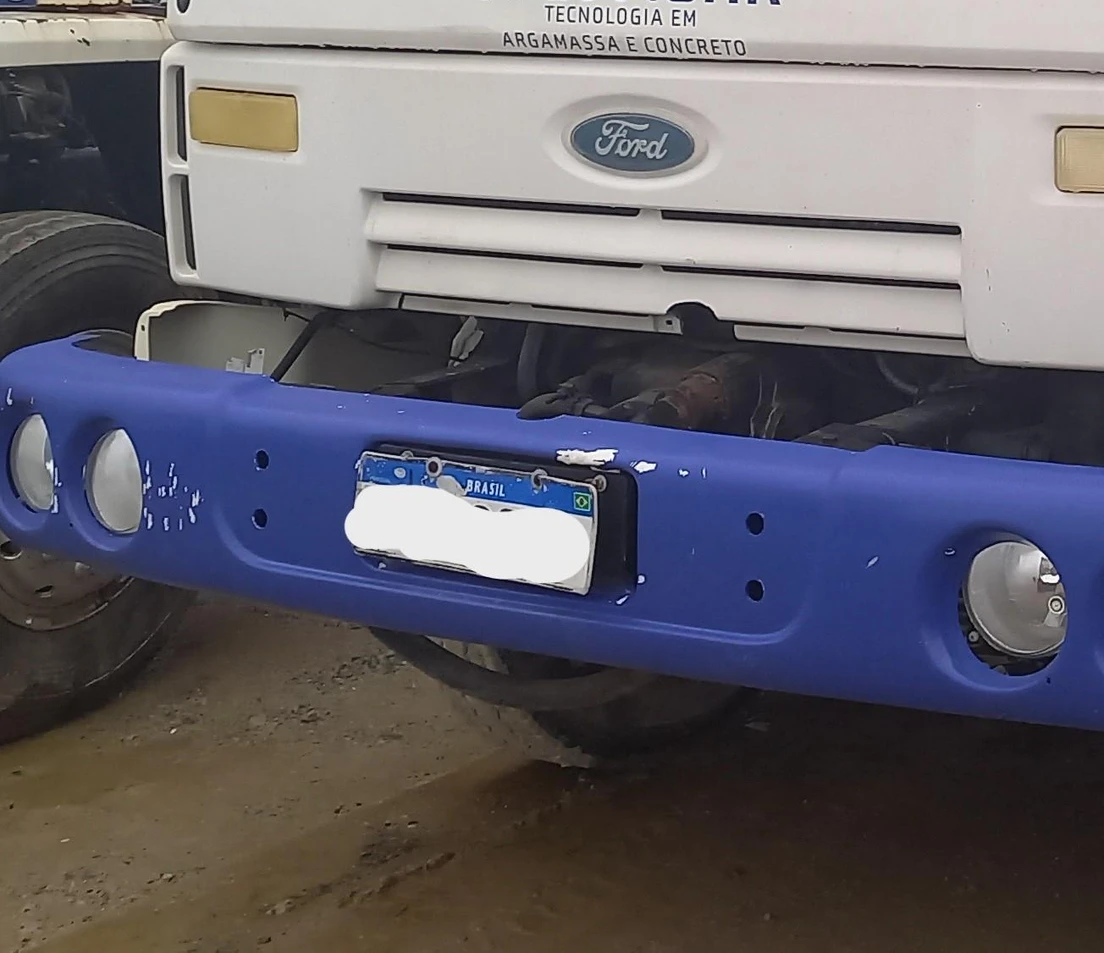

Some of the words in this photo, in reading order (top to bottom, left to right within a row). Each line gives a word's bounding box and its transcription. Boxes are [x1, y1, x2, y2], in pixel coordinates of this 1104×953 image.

[544, 4, 664, 27] TECNOLOGIA
[671, 8, 697, 28] EM
[502, 31, 621, 53] ARGAMASSA
[626, 35, 639, 53] E
[643, 36, 747, 57] CONCRETO
[594, 118, 668, 161] Ford
[466, 479, 505, 497] BRASIL
